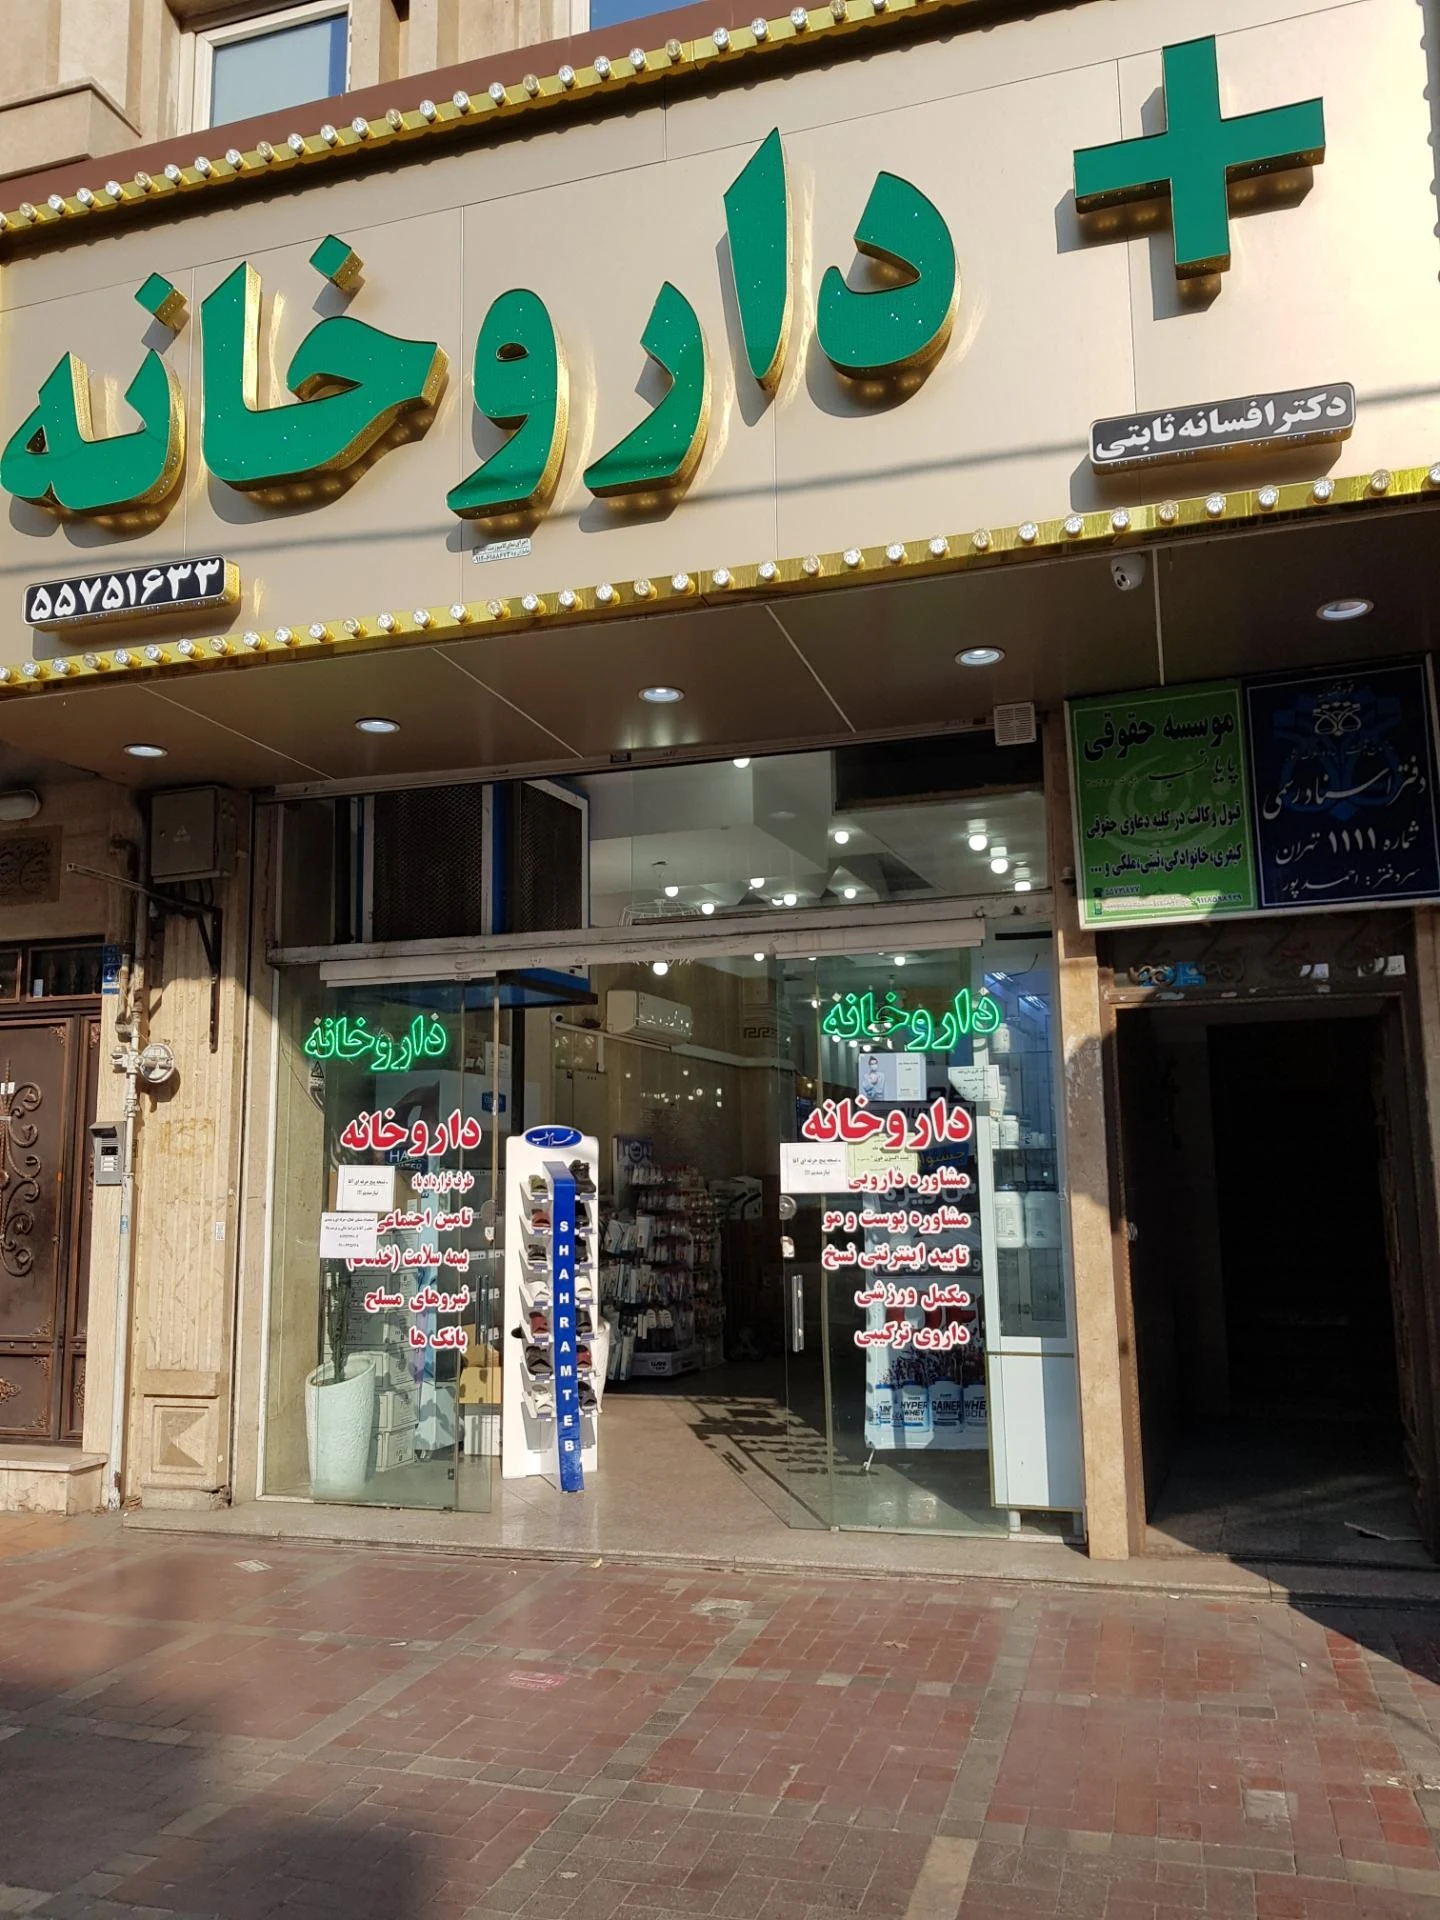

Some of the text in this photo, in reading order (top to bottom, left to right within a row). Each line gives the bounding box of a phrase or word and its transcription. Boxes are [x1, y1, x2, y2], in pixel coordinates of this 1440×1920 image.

[0, 127, 957, 519] داروخانه
[1096, 392, 1346, 459] دکتر افسانه ثابتی
[30, 559, 220, 620] ۵۵۷۵۱۶۳۳
[1084, 711, 1235, 761] موسسه حقوقی
[1262, 754, 1427, 820] دفتر اسناد رسمی
[1087, 800, 1242, 838] قبول وکالت در کلیه دعاوی حقوقی
[1274, 819, 1420, 865] شماره ۱۱۱۱ تهران
[1104, 863, 1110, 878] و
[821, 986, 1002, 1051] داروخانه
[304, 1013, 448, 1072] داروخانه
[340, 1107, 482, 1156] داروخانه
[802, 1096, 973, 1150] داروخانه
[424, 1172, 454, 1194] قرارداد
[453, 1171, 475, 1194] طرف
[848, 1169, 905, 1194] دارویی
[908, 1166, 970, 1194] مشاوره
[376, 1208, 473, 1234] تامین اجتماعی
[822, 1206, 971, 1234] مشاوره پوست و مو
[403, 1244, 442, 1267] سلامت
[443, 1247, 470, 1272] بیمه
[822, 1243, 858, 1270] نسخ
[859, 1242, 926, 1270] اینترنتی
[928, 1244, 970, 1271] تایید
[364, 1287, 470, 1312] نیروهای مسلح
[854, 1281, 970, 1311] مکمل ورزشی
[409, 1326, 468, 1352] بانک ها
[854, 1321, 970, 1350] داروی ترکیبی
[900, 1401, 929, 1410] HYPER
[931, 1401, 961, 1411] GAINER
